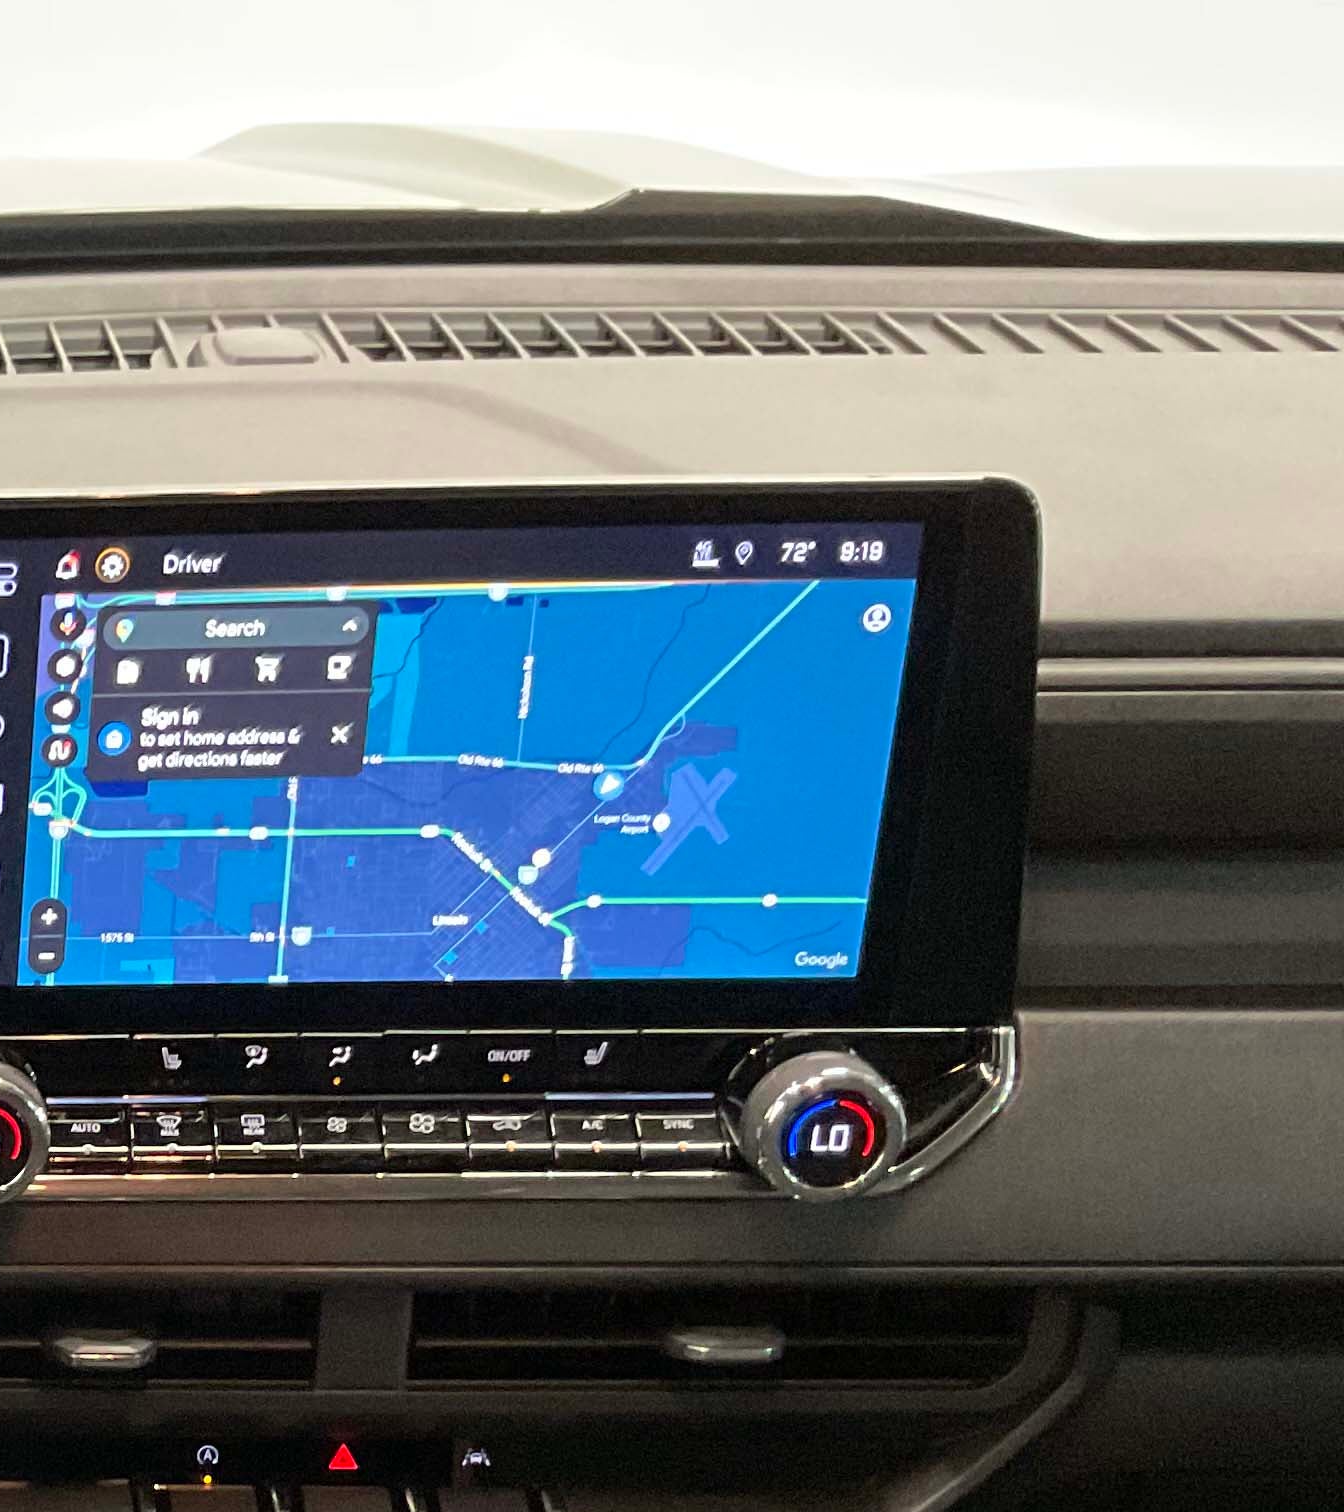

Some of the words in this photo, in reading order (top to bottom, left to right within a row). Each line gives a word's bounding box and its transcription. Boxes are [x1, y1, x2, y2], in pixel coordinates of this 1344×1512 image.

[162, 553, 223, 574] Driver
[205, 618, 266, 638] Search
[141, 706, 180, 730] Sign
[182, 706, 201, 726] in
[139, 731, 156, 748] to
[158, 731, 181, 747] set
[183, 730, 226, 747] home
[227, 728, 286, 747] address
[137, 753, 164, 772] get
[165, 750, 238, 768] directions
[239, 749, 285, 767] faster
[795, 951, 849, 969] Google
[487, 1050, 531, 1063] ON/OFF
[70, 1122, 102, 1133] AUTO
[581, 1119, 605, 1131] A/C
[663, 1119, 695, 1131] SYNC
[810, 1124, 850, 1152] LO
